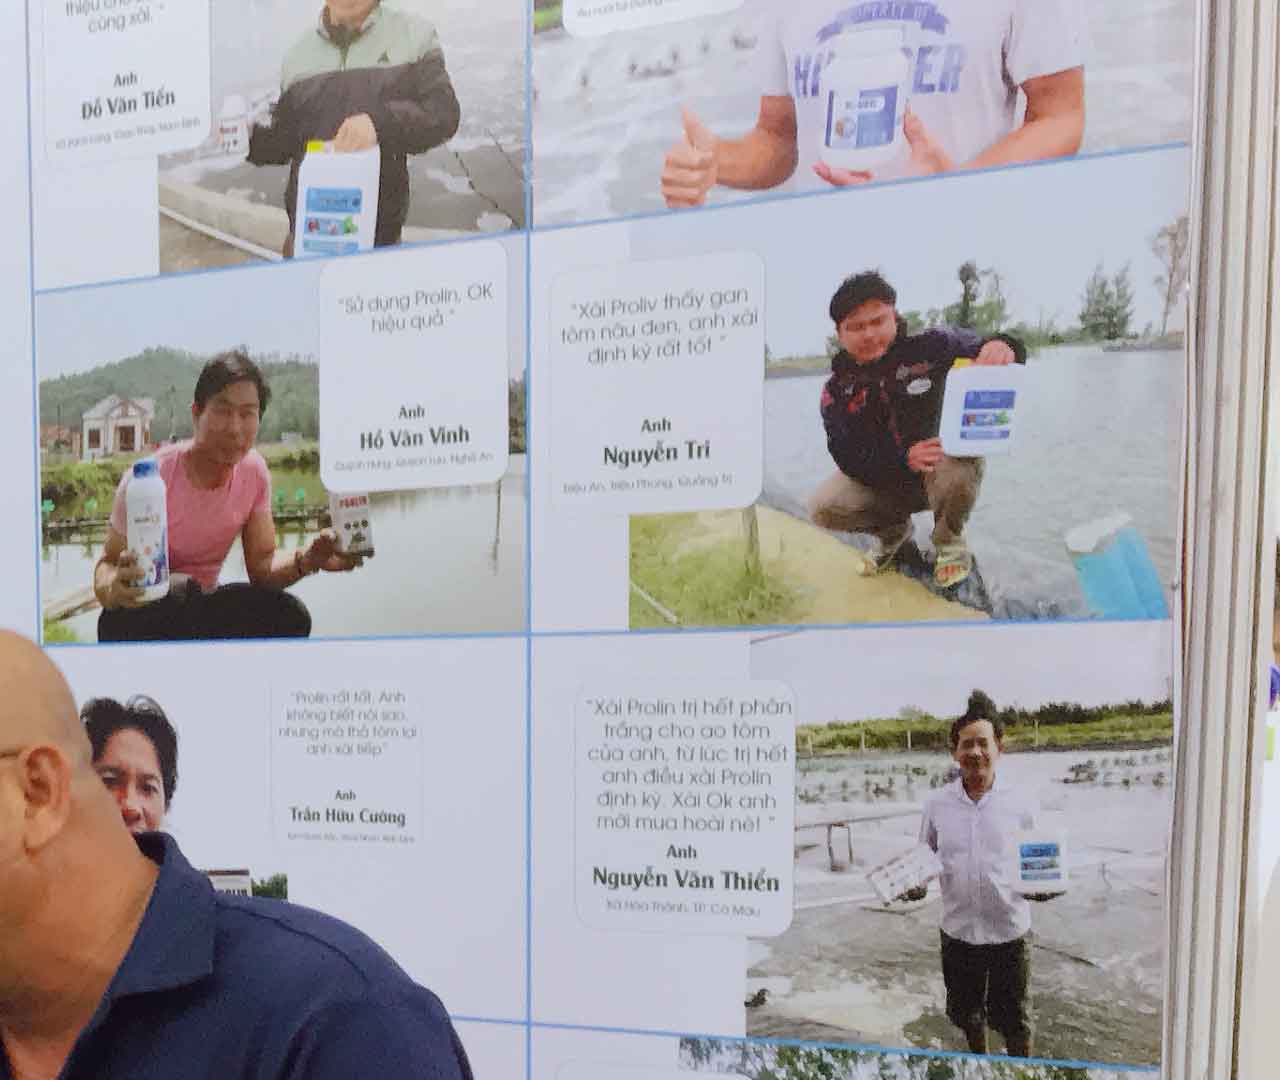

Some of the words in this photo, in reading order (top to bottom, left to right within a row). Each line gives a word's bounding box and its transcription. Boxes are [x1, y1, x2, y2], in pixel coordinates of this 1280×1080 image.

[113, 72, 138, 88] Anh
[106, 96, 137, 115] Văn
[398, 405, 425, 420] Anh
[641, 417, 672, 434] Anh
[389, 428, 423, 447] Văn
[430, 425, 470, 444] Vinh
[603, 440, 679, 469] Nguyễn
[335, 789, 356, 801] Anh
[666, 844, 698, 860] Anh
[593, 865, 668, 891] Nguyễn
[675, 869, 715, 890] Văn
